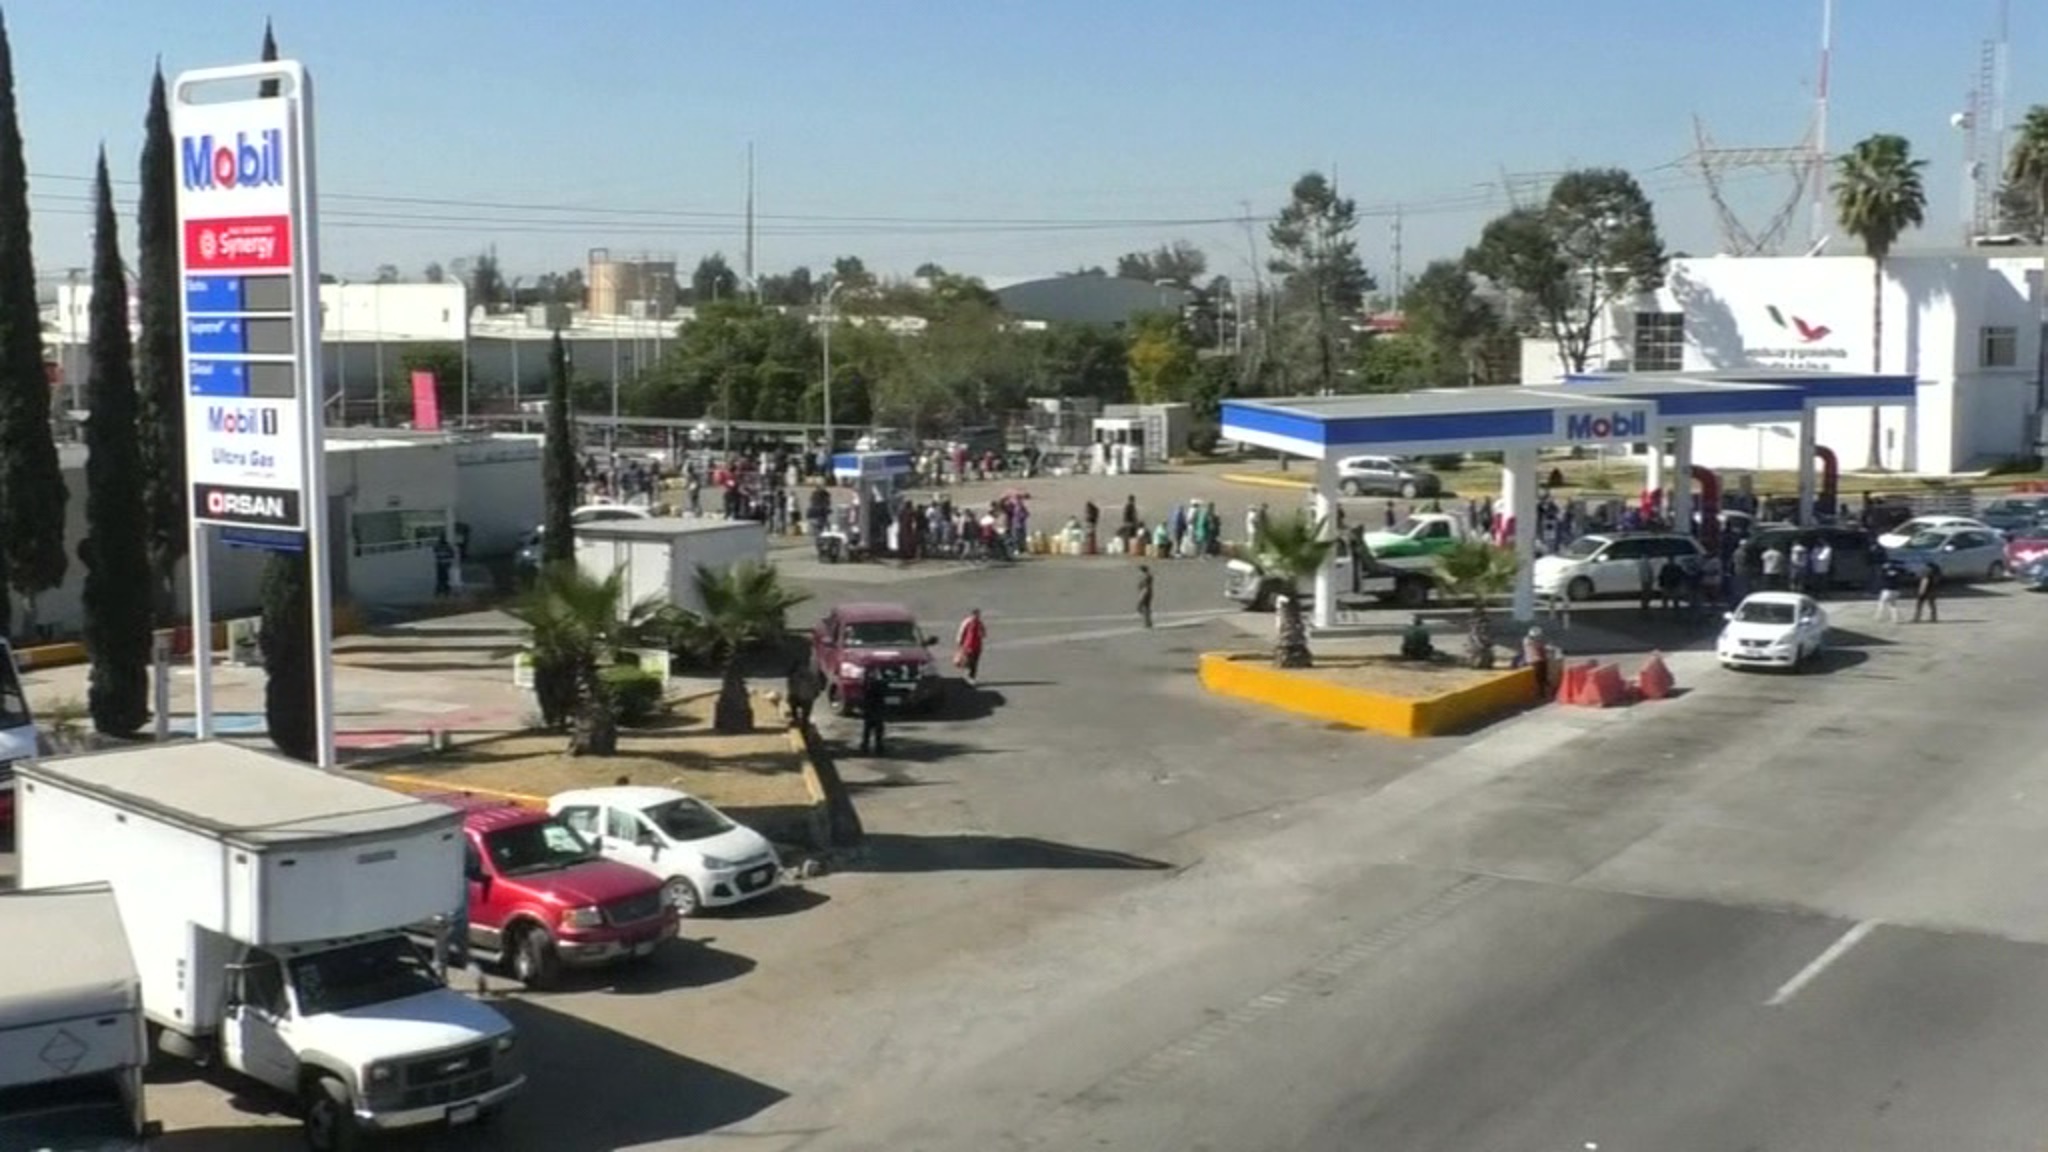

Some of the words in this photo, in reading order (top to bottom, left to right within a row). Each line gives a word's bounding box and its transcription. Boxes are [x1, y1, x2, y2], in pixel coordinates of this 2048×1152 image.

[182, 128, 283, 190] Mobil
[219, 231, 275, 259] Synergy
[208, 406, 258, 434] Mobil
[262, 409, 276, 434] 1
[1567, 411, 1645, 440] Mobil
[212, 448, 246, 465] Ultra
[250, 450, 274, 467] Gas
[208, 491, 285, 518] ORSAN
